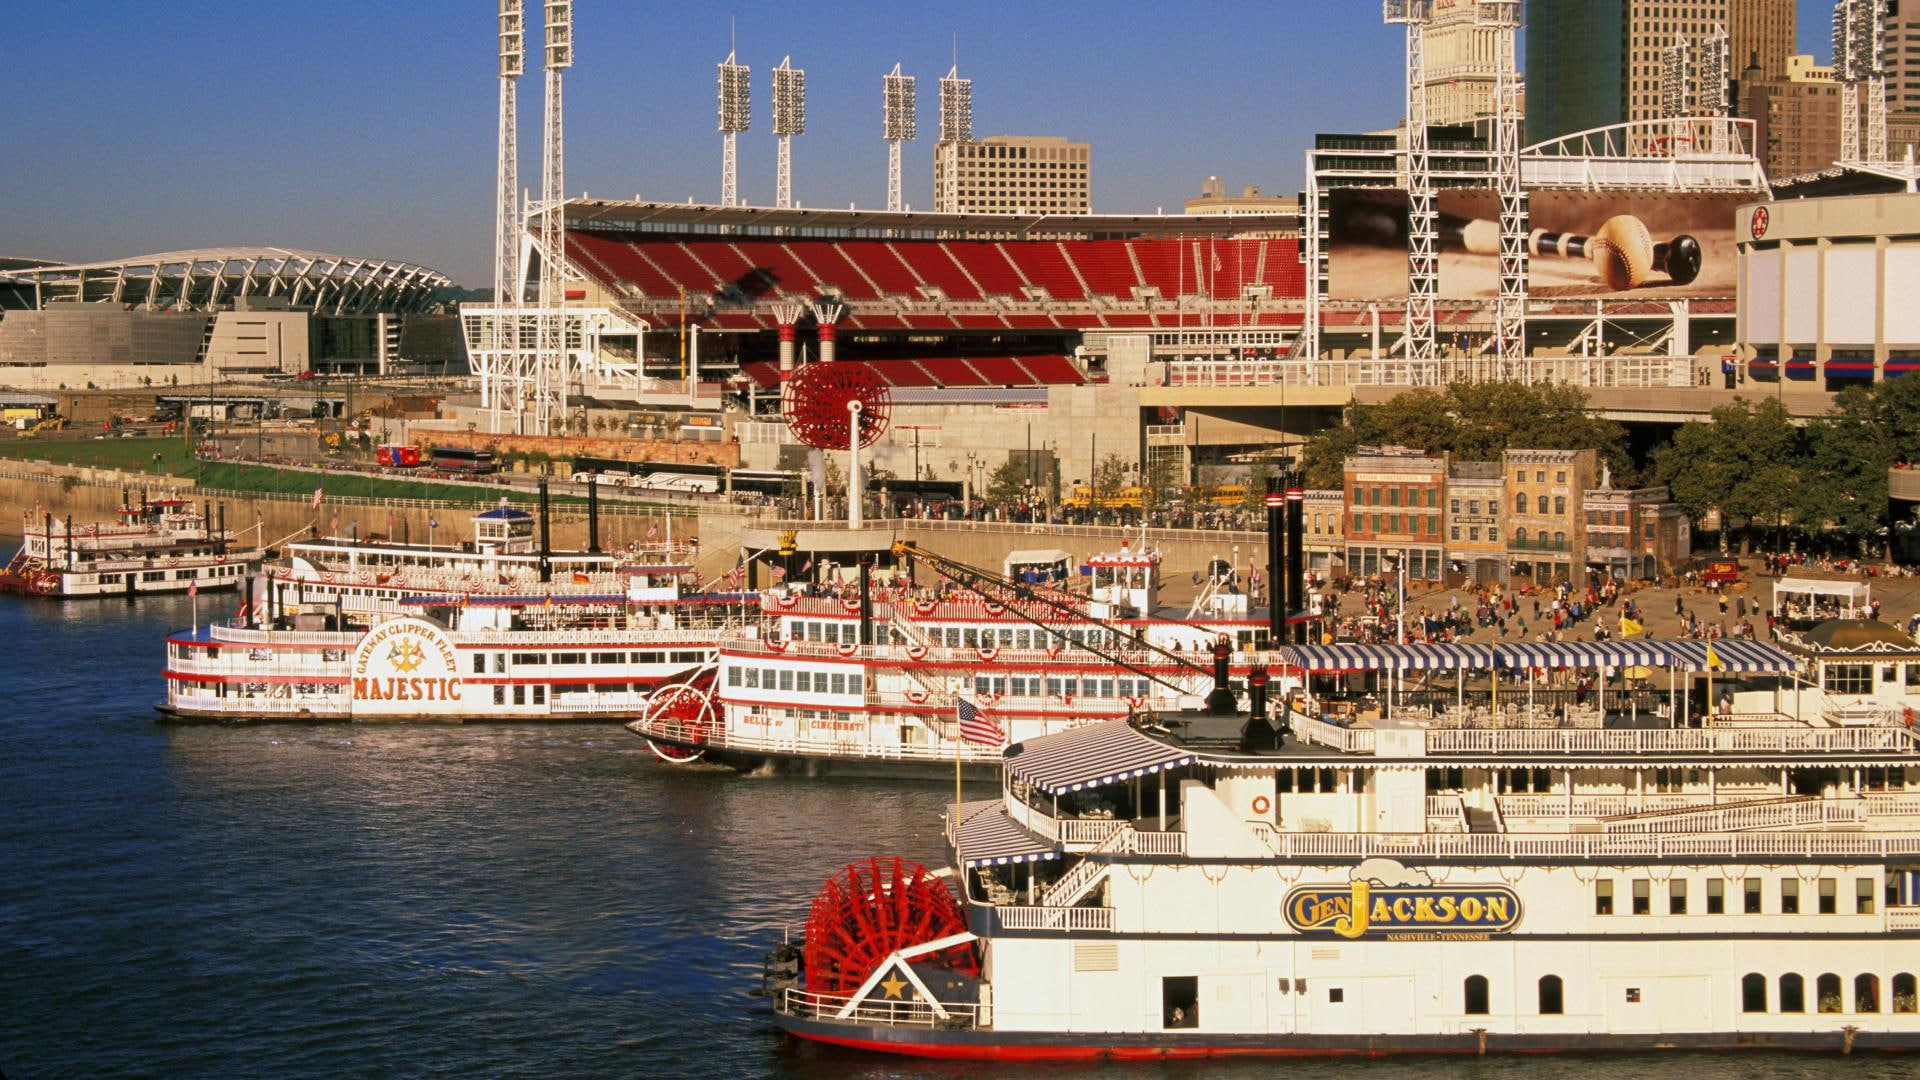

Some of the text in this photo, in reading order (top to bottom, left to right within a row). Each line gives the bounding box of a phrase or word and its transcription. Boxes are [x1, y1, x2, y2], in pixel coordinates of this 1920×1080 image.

[356, 624, 457, 674] GATEWAY CLIPPER FLEET
[353, 677, 461, 700] MAJESTIC
[743, 715, 772, 727] BELLE
[1387, 933, 1490, 941] NASHVILLE TENNESSEE
